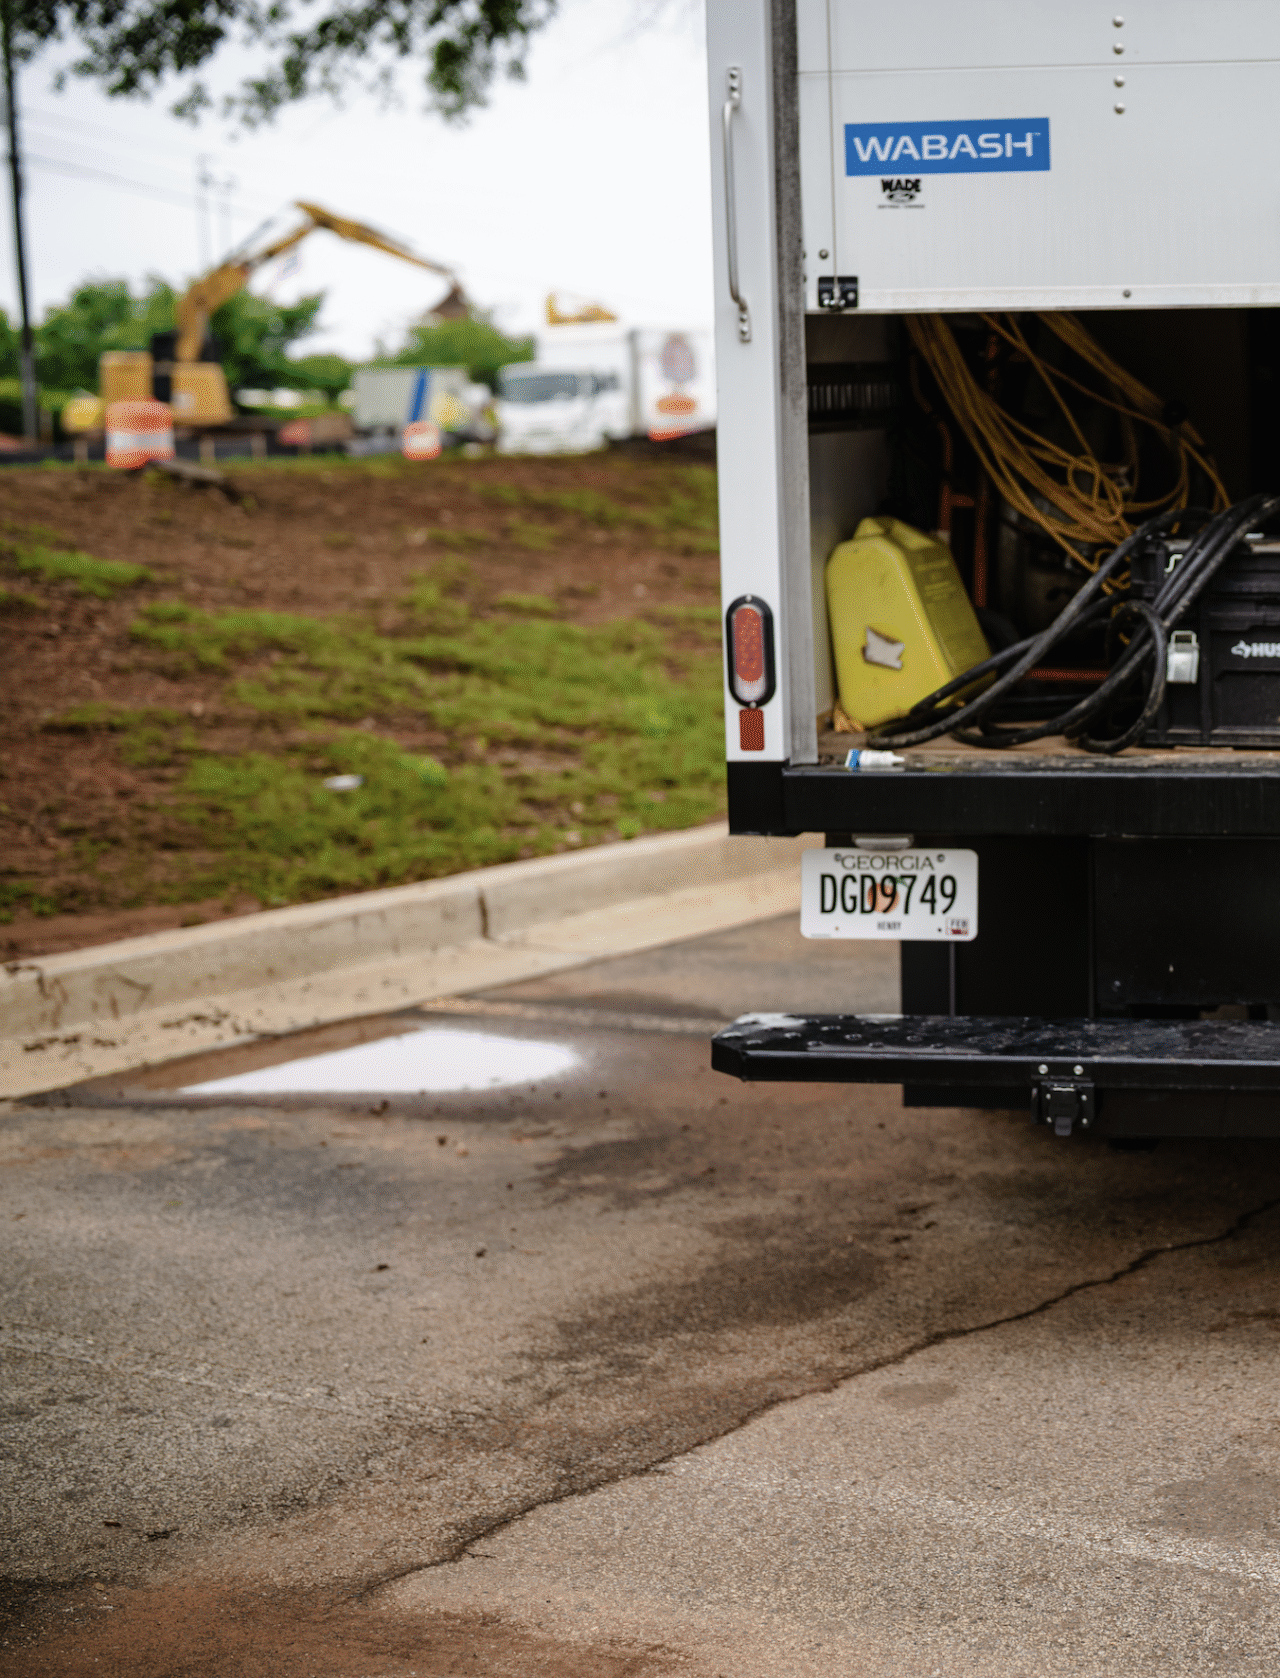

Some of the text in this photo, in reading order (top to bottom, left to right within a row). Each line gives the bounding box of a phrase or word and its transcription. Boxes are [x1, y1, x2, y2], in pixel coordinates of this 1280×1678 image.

[853, 132, 1034, 162] WABASH
[881, 178, 922, 193] WADE
[841, 854, 936, 872] GEORGIA
[820, 873, 958, 915] DGD9749
[876, 920, 902, 931] HENRY
